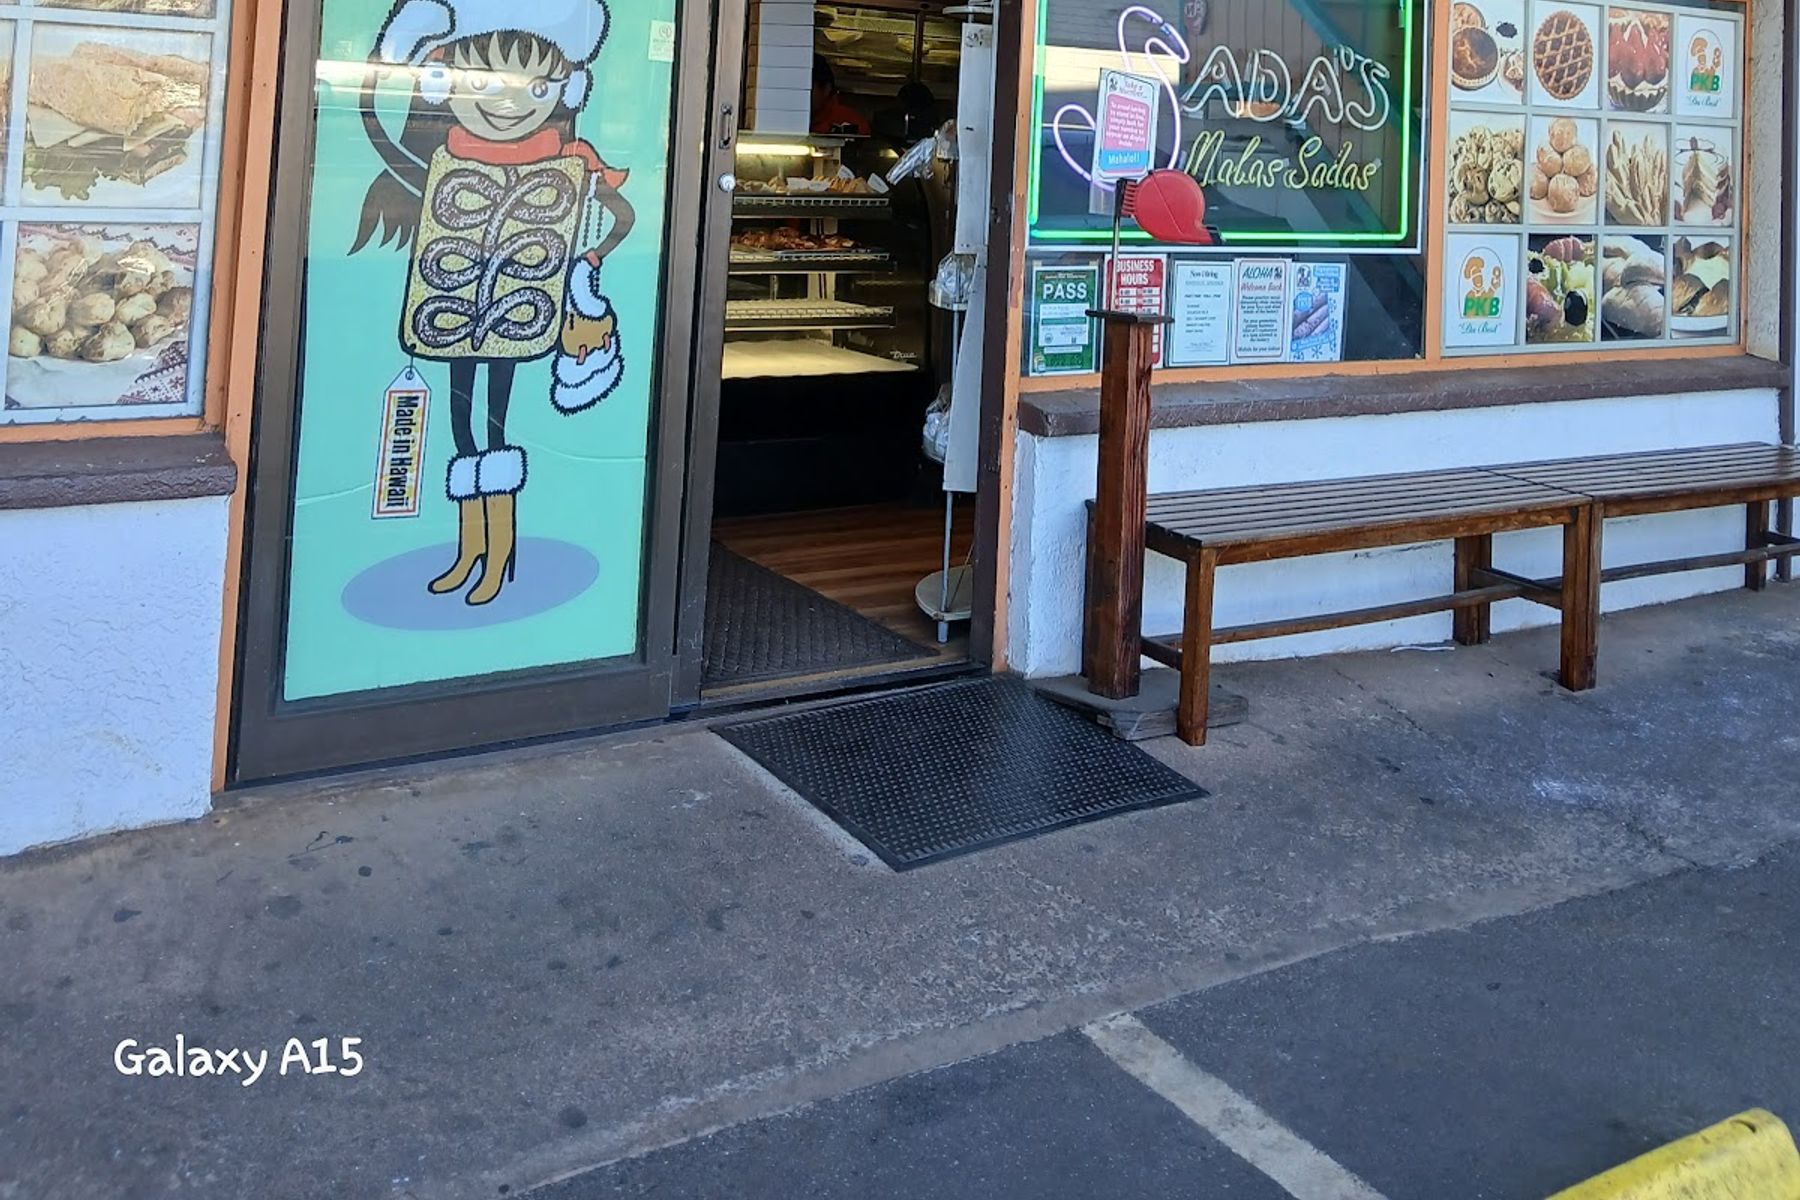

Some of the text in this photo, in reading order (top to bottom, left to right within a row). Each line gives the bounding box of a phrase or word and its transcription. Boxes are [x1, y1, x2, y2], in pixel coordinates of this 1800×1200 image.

[1120, 272, 1149, 285] HOURS
[1242, 266, 1273, 279] ALOHA
[1042, 282, 1087, 300] PASS
[1463, 297, 1500, 317] PKB
[386, 395, 420, 507] Made in Hawaii
